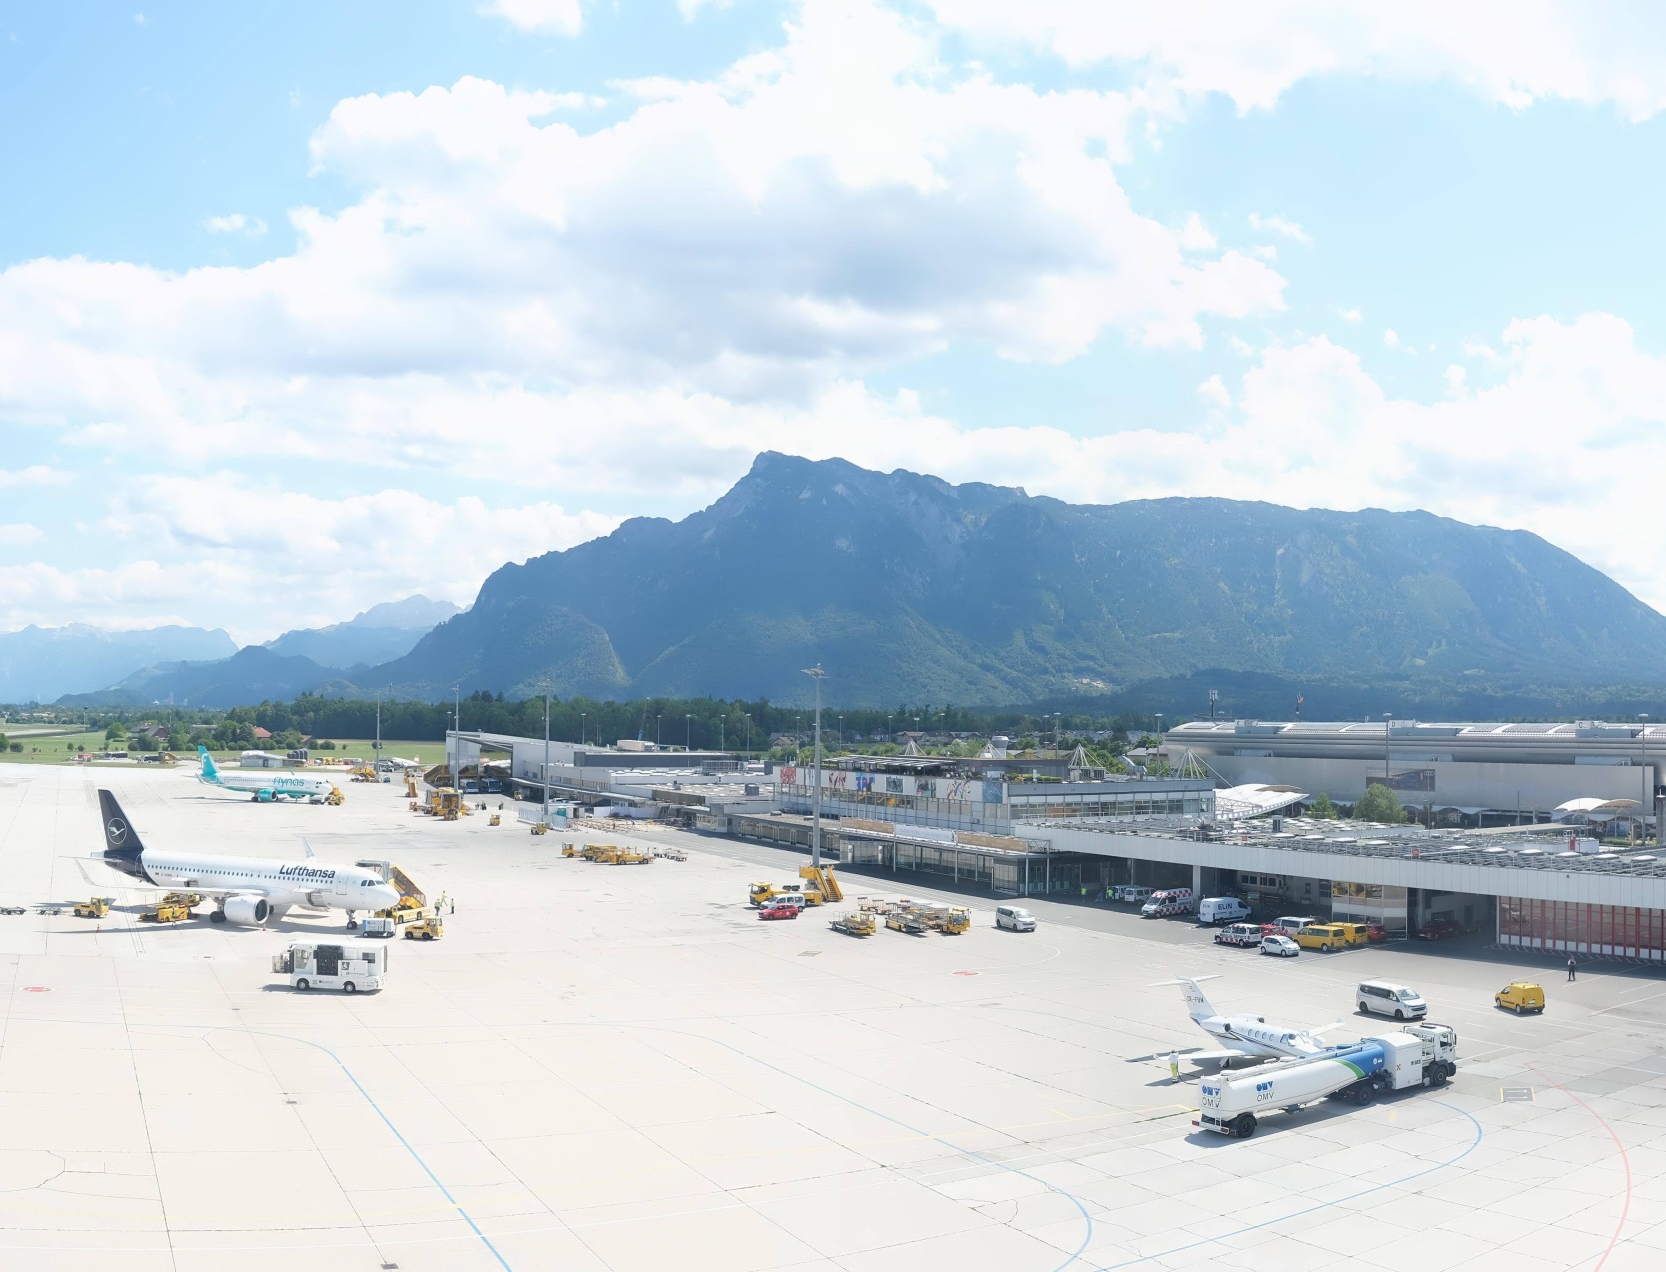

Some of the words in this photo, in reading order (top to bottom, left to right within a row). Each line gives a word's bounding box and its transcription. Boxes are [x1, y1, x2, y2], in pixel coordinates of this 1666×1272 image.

[273, 776, 305, 787] flynas
[279, 864, 336, 879] Lufthansa
[1201, 1097, 1220, 1108] OMV
[1256, 1092, 1274, 1102] OMV
